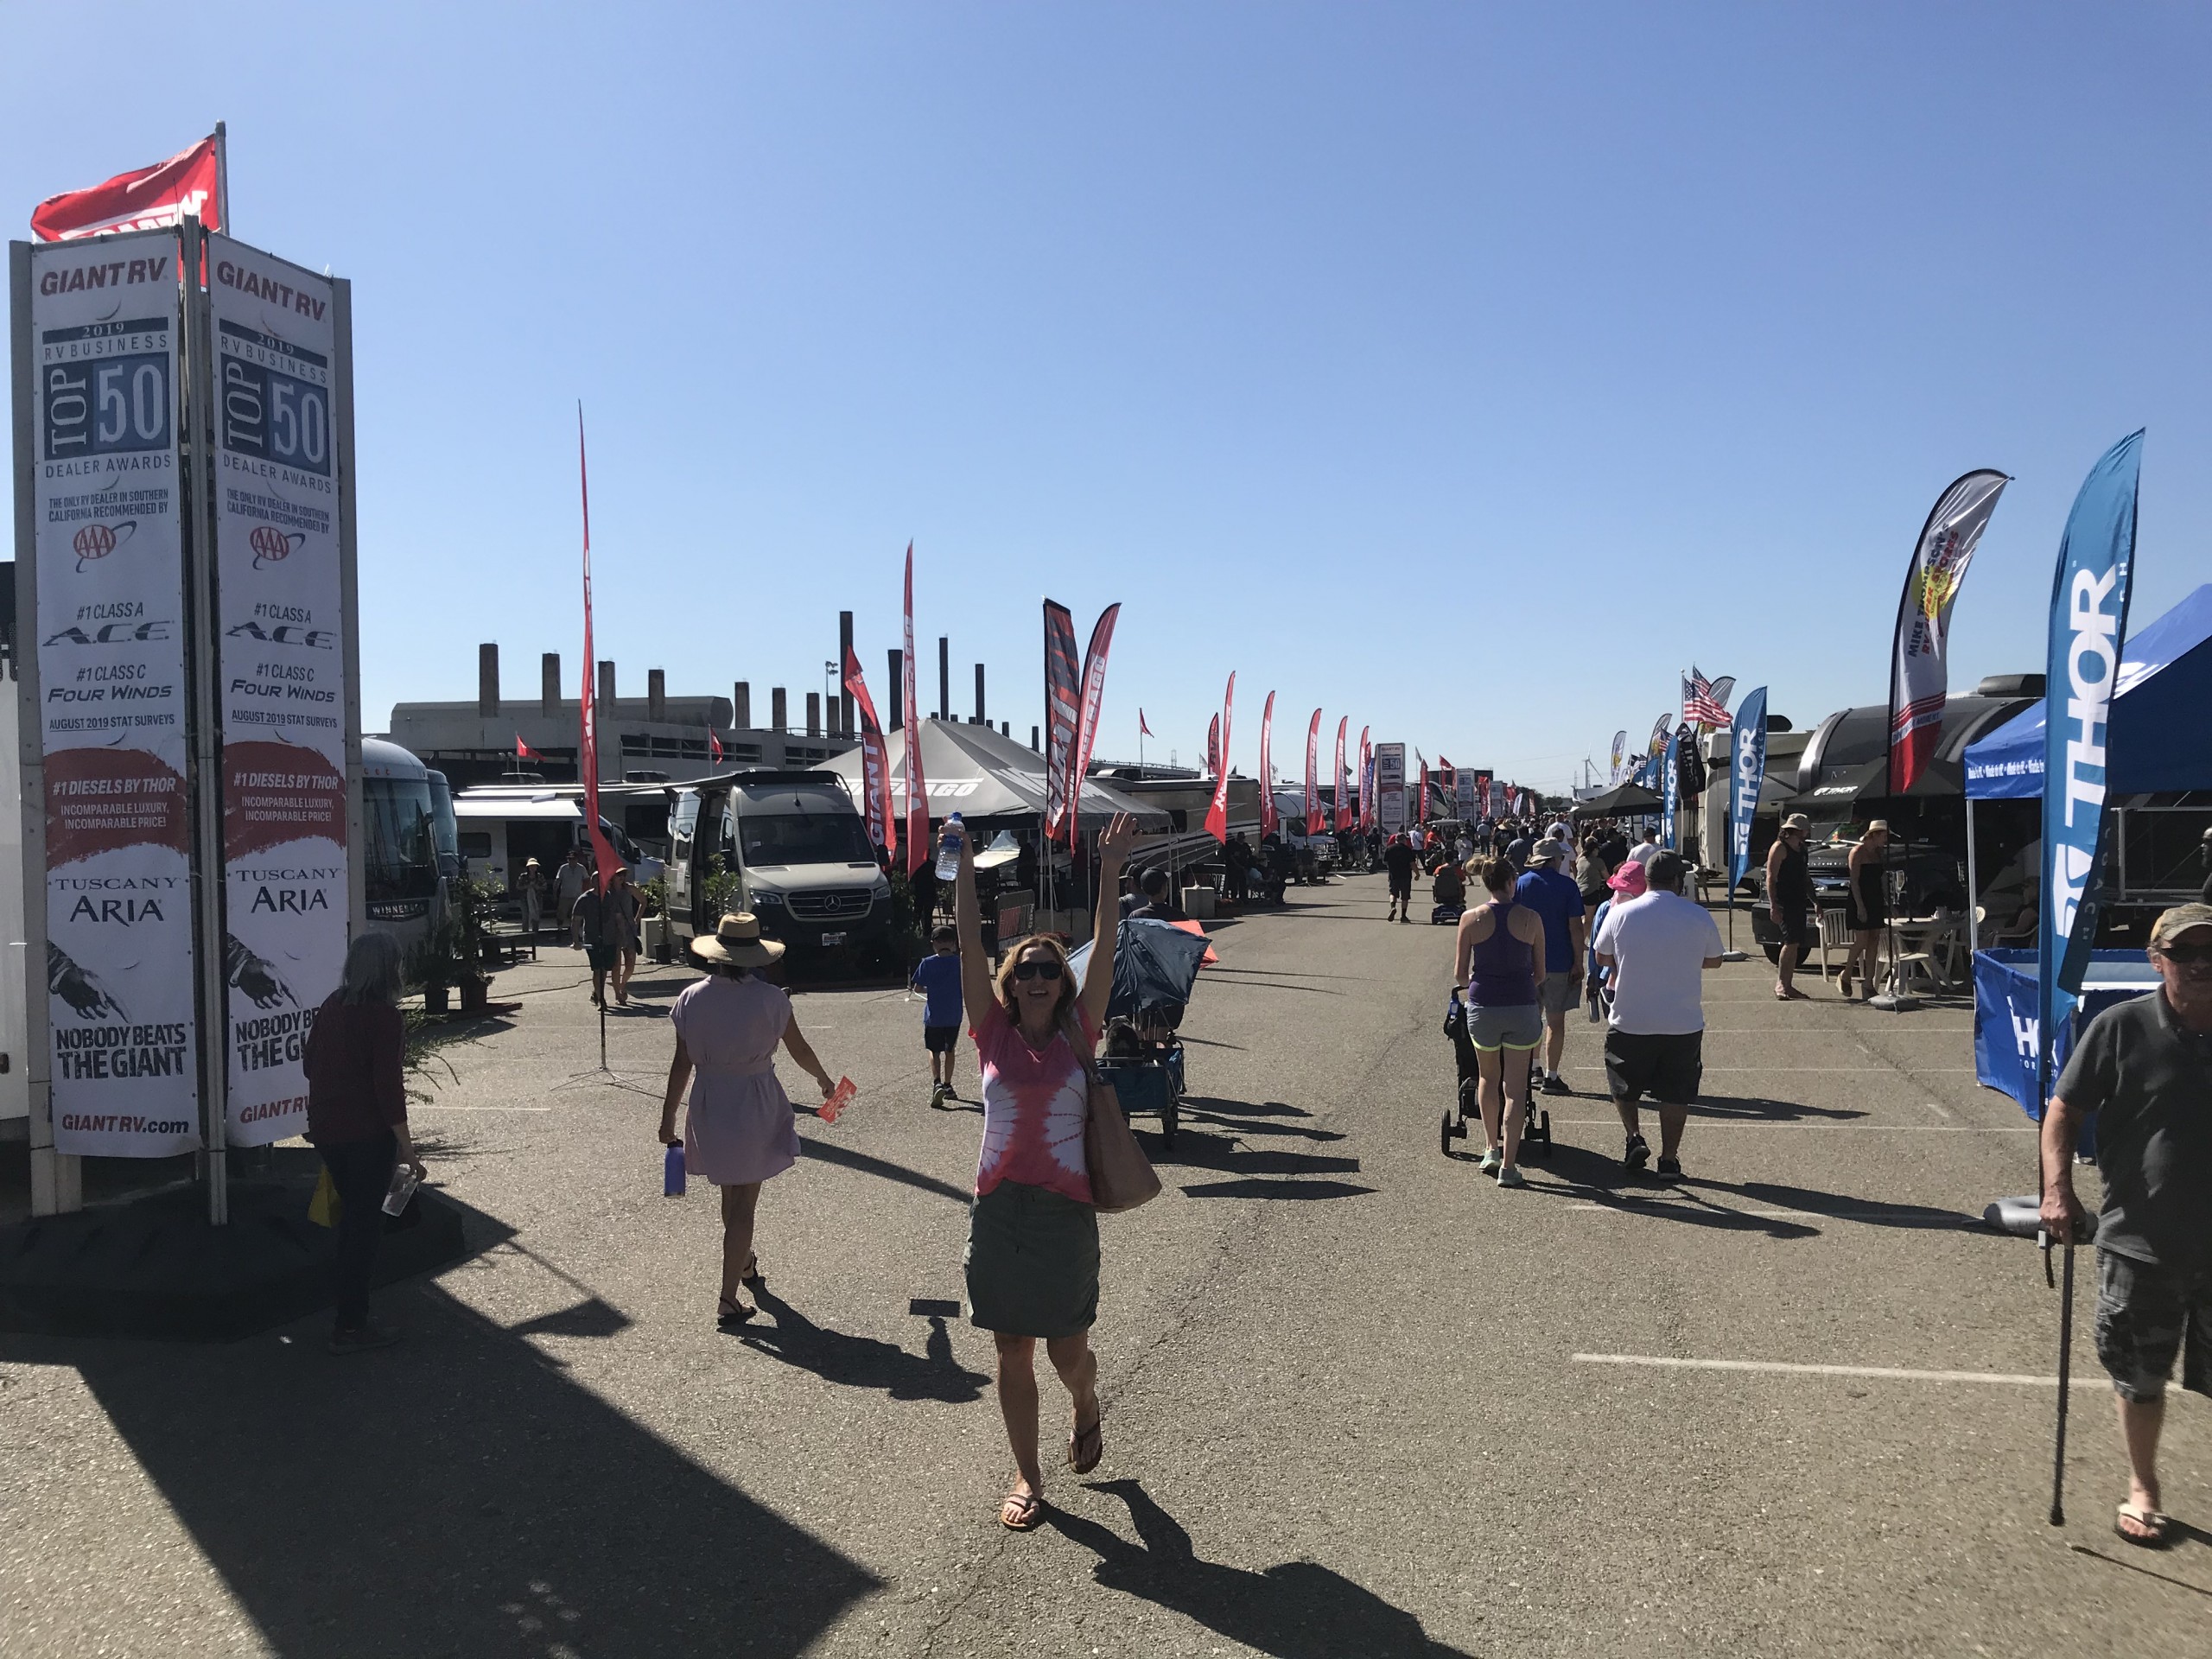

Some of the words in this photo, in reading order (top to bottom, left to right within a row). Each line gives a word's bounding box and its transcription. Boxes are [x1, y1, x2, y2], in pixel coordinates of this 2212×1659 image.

[82, 323, 124, 338] 2019
[257, 334, 294, 354] 2019
[50, 368, 86, 454] TOP
[98, 364, 164, 443] 50
[226, 361, 262, 448] TOP
[272, 380, 324, 464] 50
[46, 460, 99, 479] DEALER
[106, 454, 170, 472] AWARDS
[224, 454, 276, 479] DEALER
[283, 470, 331, 493] AWARDS
[49, 498, 61, 509] THE
[64, 497, 79, 508] ONLY
[81, 495, 89, 505] RV
[91, 493, 118, 505] DEALER
[120, 492, 127, 502] IN
[130, 489, 168, 501] SOUTHERN
[227, 488, 238, 500] THE
[240, 491, 256, 505] ONLY
[257, 496, 266, 506] RV
[268, 498, 290, 512] DEALER
[291, 504, 298, 513] IN
[299, 506, 329, 522] SOUTHERN
[49, 507, 92, 523] CALIFORNIA
[94, 502, 156, 518] RECOMMENDED
[159, 502, 168, 513] BY
[227, 501, 269, 521] CALIFORNIA
[271, 511, 320, 531] RECOMMENDED
[321, 522, 328, 534] BY
[77, 524, 112, 558] AAA
[252, 527, 288, 560] AAA
[77, 606, 91, 620] #1
[94, 602, 133, 620] CLASS
[135, 601, 143, 616] A
[254, 603, 266, 616] #1
[270, 604, 303, 622] CLASS
[305, 610, 311, 624] A
[1924, 586, 1934, 632] SUPER
[1908, 621, 1923, 658] MIKE
[1921, 634, 1930, 655] RV
[77, 668, 92, 682] #1
[95, 664, 134, 681] CLASS
[137, 664, 146, 678] C
[257, 663, 269, 677] #1
[271, 664, 305, 681] CLASS
[308, 668, 314, 682] C
[48, 688, 105, 702] FOUR
[111, 685, 172, 700] WINDS
[231, 679, 282, 697] FOUR
[288, 684, 334, 702] WINDS
[2065, 564, 2117, 828] THOR
[49, 718, 85, 729] AUGUST
[86, 718, 109, 728] 2019
[111, 716, 132, 728] STAT
[135, 714, 175, 726] SURVEYS
[232, 709, 265, 721] AUGUST
[266, 713, 285, 723] 2019
[287, 715, 304, 725] STAT
[306, 715, 337, 728] SURVEYS
[1390, 759, 1401, 769] 50
[1738, 728, 1758, 817] THOR
[53, 781, 67, 795] #1
[69, 779, 123, 795] DIESELS
[124, 779, 141, 793] BY
[143, 778, 175, 792] THOR
[234, 772, 247, 786] #1
[249, 772, 295, 788] DIESELS
[296, 775, 311, 788] BY
[312, 775, 338, 789] THOR
[1668, 760, 1677, 816] THOR
[242, 797, 302, 808] INCOMPARABLE
[305, 798, 334, 809] LUXURY,
[865, 738, 885, 848] GIANT
[61, 804, 132, 816] INCOMPARABLE
[134, 802, 169, 814] LUXURY,
[245, 810, 306, 822] INCOMPARABLE
[308, 811, 332, 822] PRICE!
[65, 817, 137, 830] INCOMPARABLE
[138, 817, 166, 828] PRICE!
[55, 877, 181, 891] TUSCANY
[236, 868, 340, 881] TUSCANY
[69, 896, 164, 927] ARIA
[251, 887, 328, 916] ARIA
[56, 1027, 130, 1050] NOBODY
[133, 1023, 186, 1046] BEATS
[236, 1011, 301, 1044] NOBODY
[57, 1050, 108, 1079] THE
[111, 1046, 187, 1077] GIANT
[237, 1037, 283, 1071] THE
